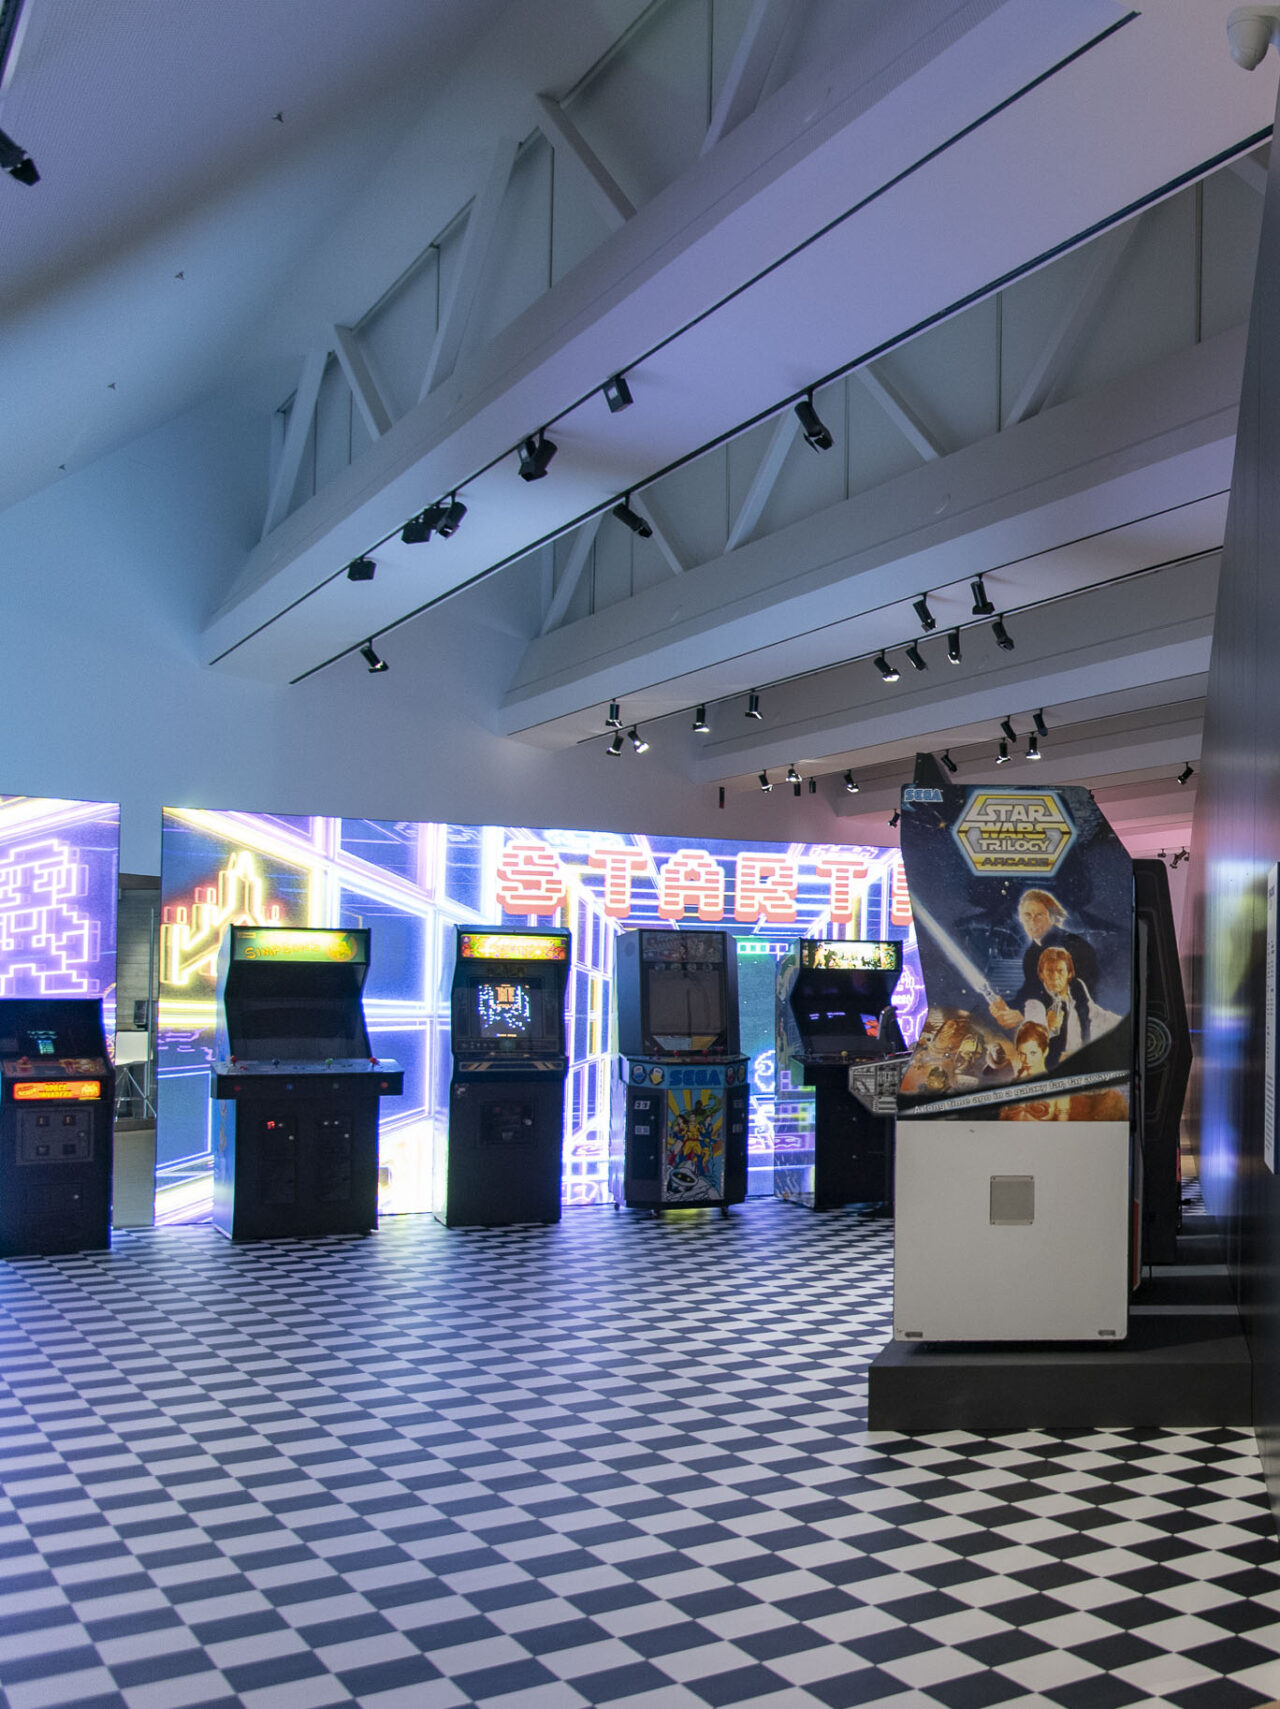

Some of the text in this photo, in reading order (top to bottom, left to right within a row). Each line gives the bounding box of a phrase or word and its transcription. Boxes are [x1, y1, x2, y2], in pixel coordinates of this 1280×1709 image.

[904, 788, 943, 802] SEGA
[964, 804, 1065, 822] STAR
[978, 838, 1050, 851] TRILOGY
[980, 857, 1050, 867] ARCADE
[668, 1069, 722, 1087] SEGA
